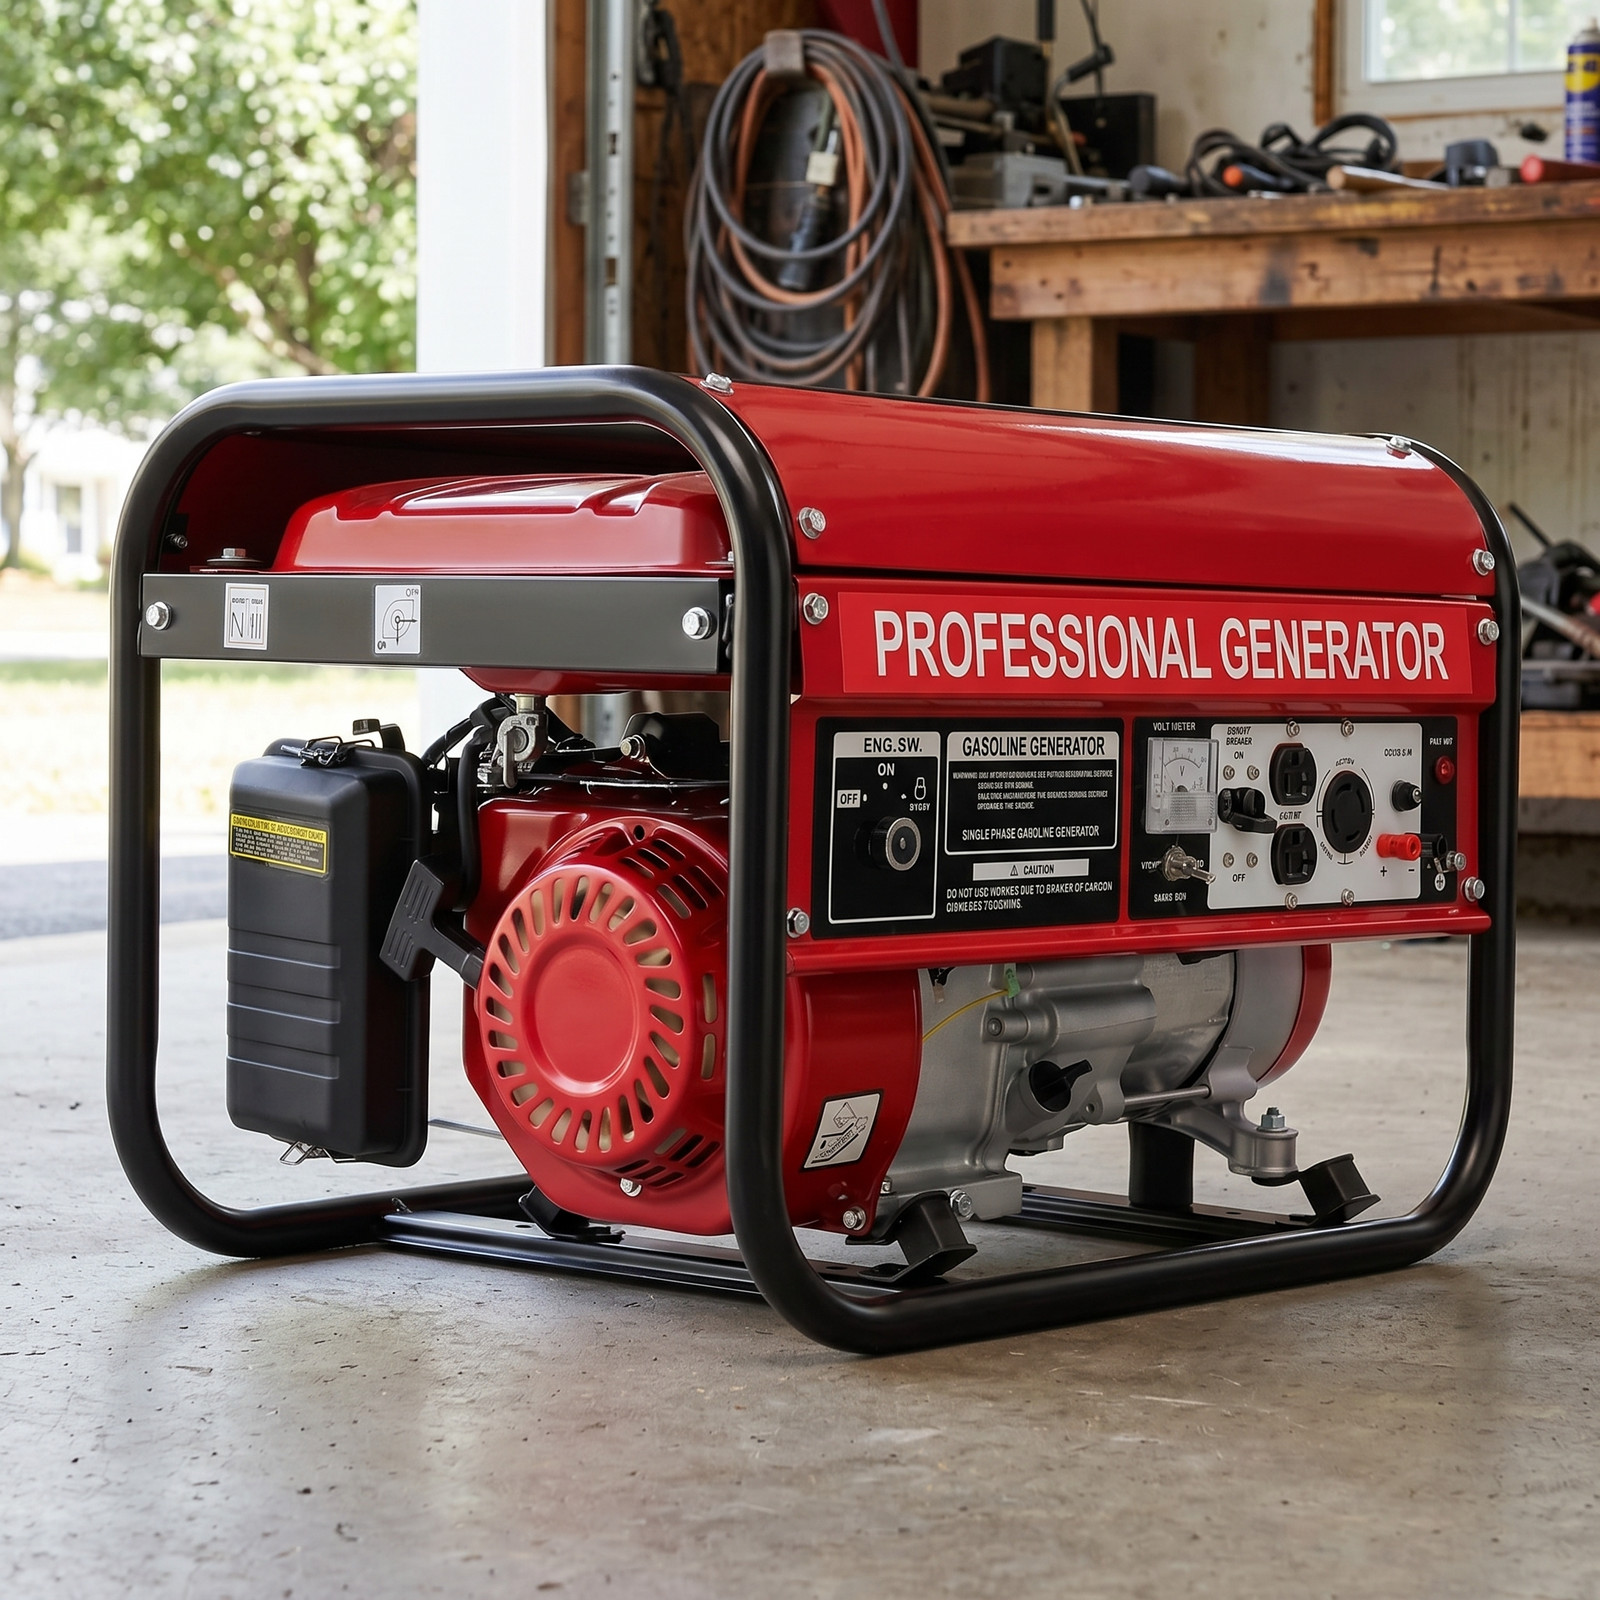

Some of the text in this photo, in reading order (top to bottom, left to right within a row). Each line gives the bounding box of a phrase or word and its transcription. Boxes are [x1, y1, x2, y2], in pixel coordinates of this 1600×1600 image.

[874, 610, 1449, 680] PROFESSIONAL GENERATOR
[1153, 722, 1170, 731] VOLT
[863, 737, 923, 753] ENG.SW.
[962, 736, 1105, 756] GASOLINE GENERATOR
[1234, 751, 1244, 760] ON
[877, 763, 895, 776] ON
[1180, 765, 1185, 776] V
[840, 793, 858, 805] OFF
[962, 828, 990, 841] SINGLE
[990, 827, 1016, 840] PHASE
[1055, 825, 1100, 838] GENERATOR
[1023, 864, 1055, 875] CAUTION
[1232, 873, 1246, 882] OFF
[946, 888, 957, 899] DO
[958, 887, 973, 898] NOT
[1020, 884, 1034, 895] DUE
[1035, 884, 1045, 894] TO
[1075, 882, 1084, 892] OF
